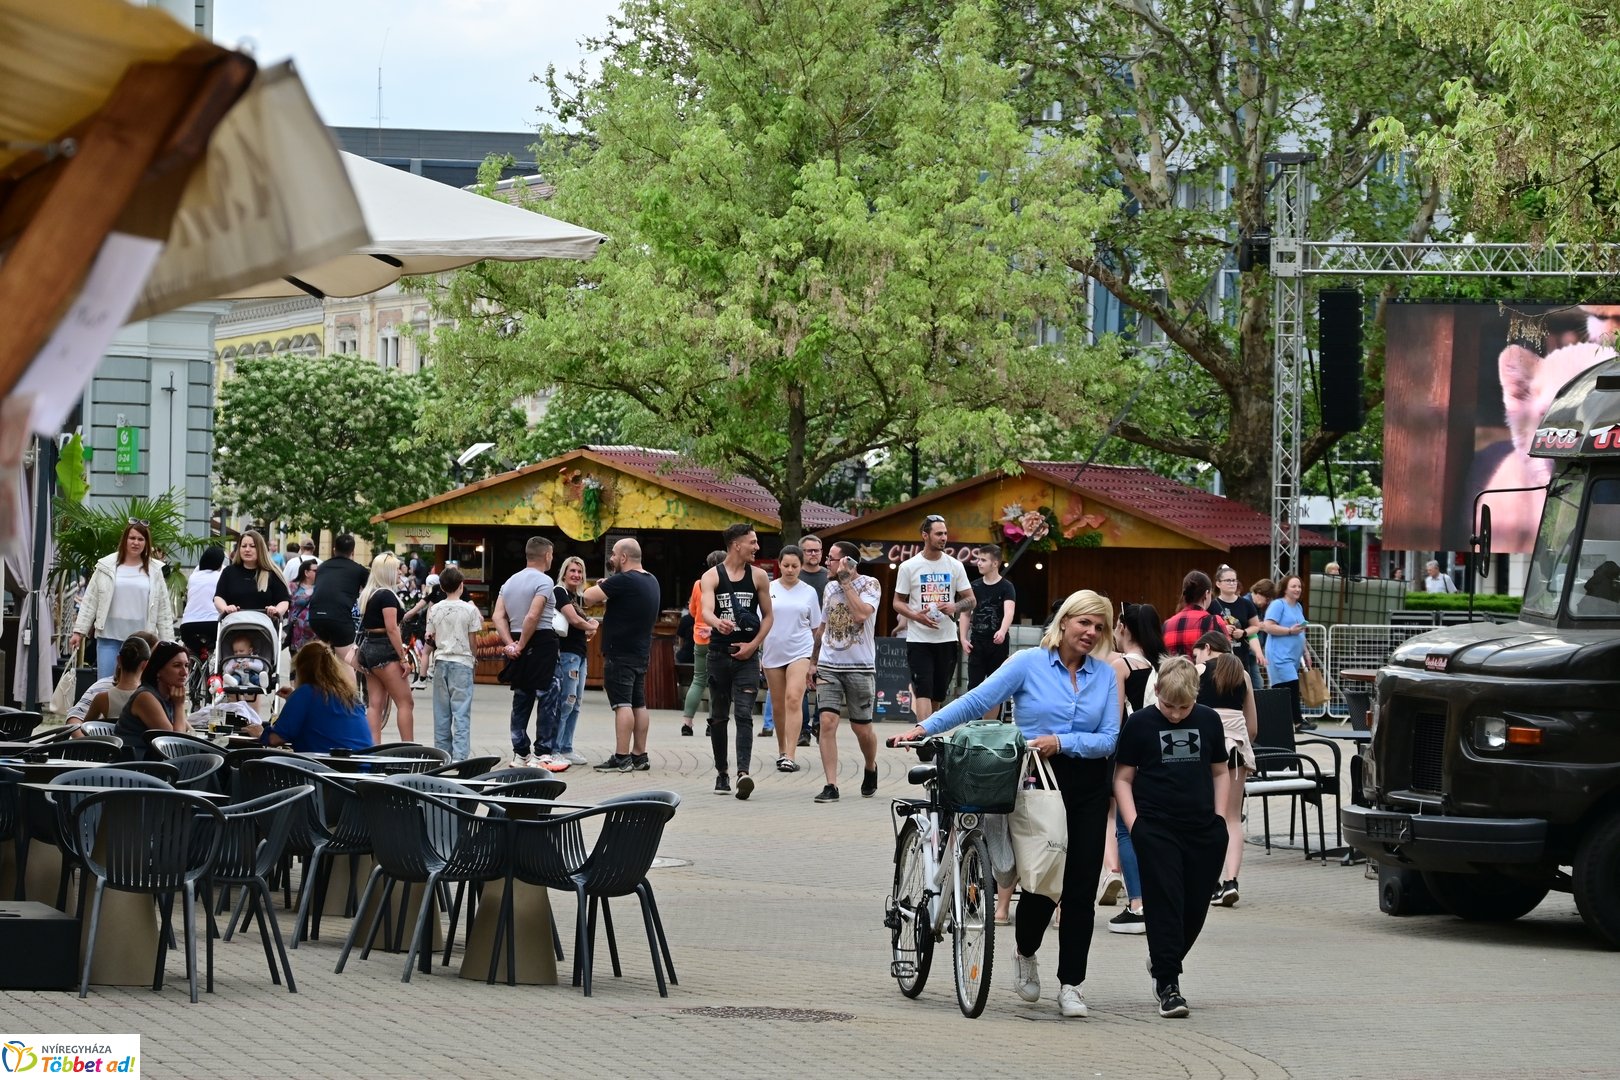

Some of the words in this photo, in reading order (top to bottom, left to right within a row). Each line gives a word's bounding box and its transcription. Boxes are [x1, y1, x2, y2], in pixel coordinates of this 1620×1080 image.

[926, 574, 945, 582] SUN
[921, 584, 950, 592] BEACH
[923, 594, 949, 602] WAVES
